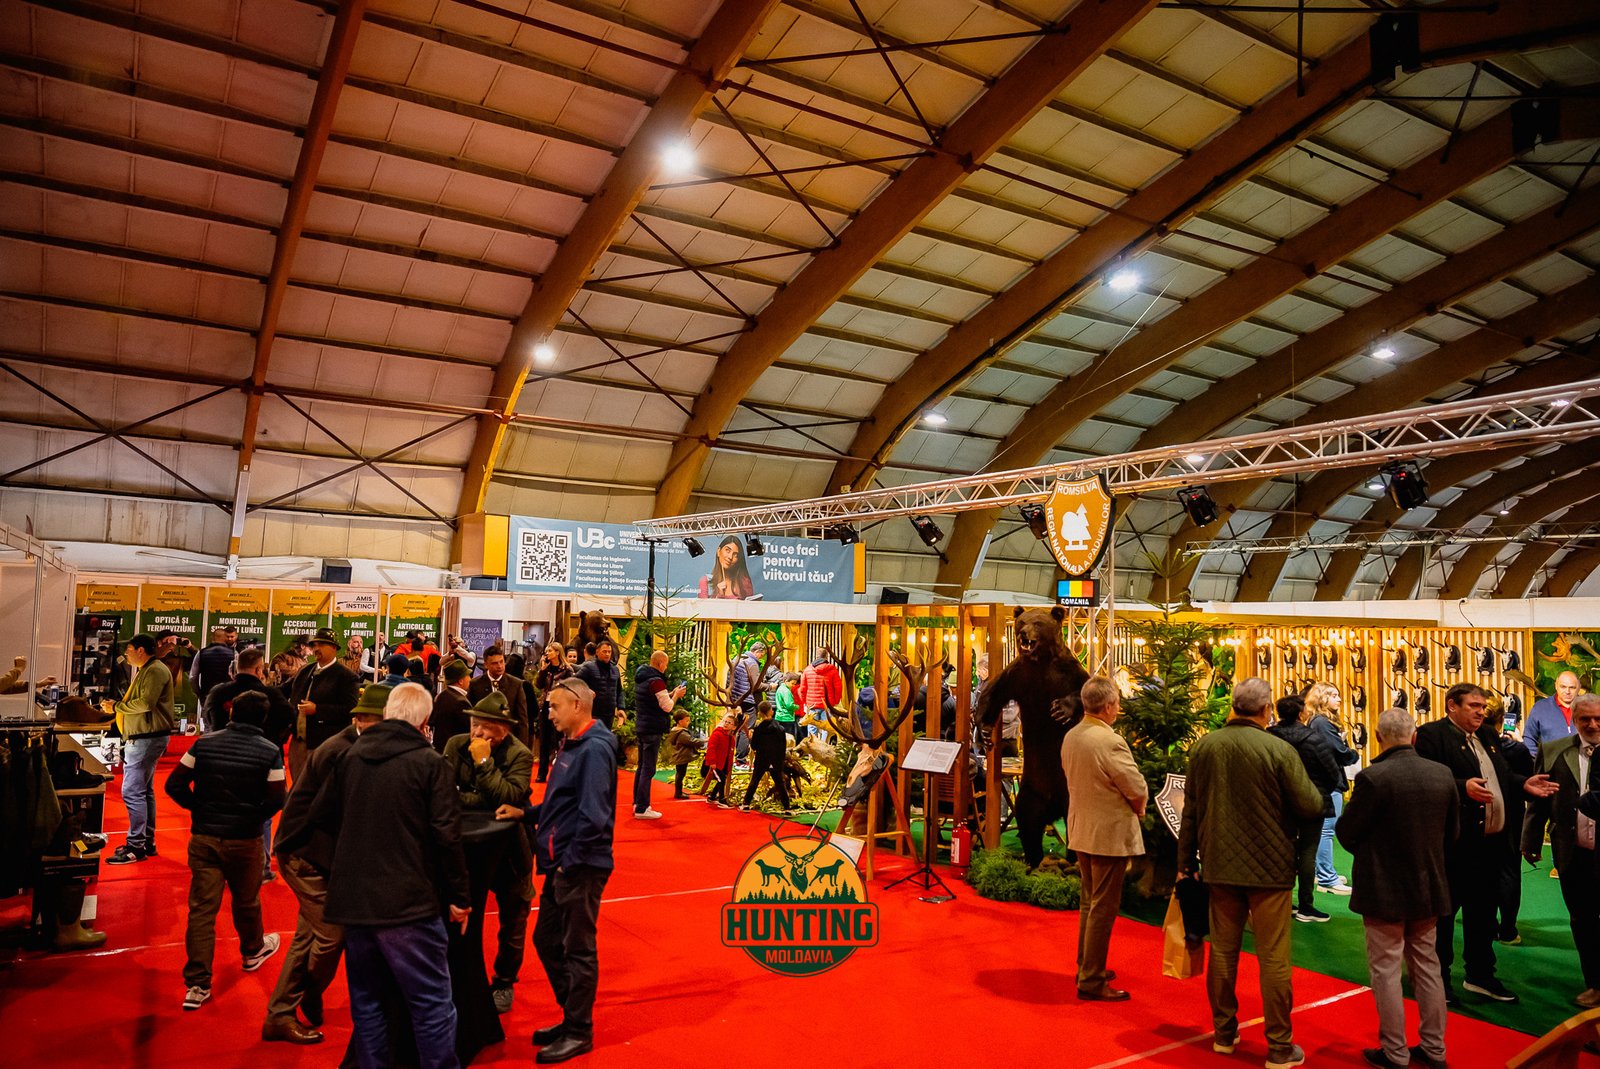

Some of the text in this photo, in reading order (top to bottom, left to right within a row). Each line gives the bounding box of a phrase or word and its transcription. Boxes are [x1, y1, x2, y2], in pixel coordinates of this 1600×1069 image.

[1057, 482, 1098, 496] ROMSILVA
[1046, 507, 1057, 538] REGIA
[1087, 502, 1110, 560] PADURILOR
[763, 542, 819, 556] Tu ce faci
[1051, 538, 1084, 574] NATIONALA
[762, 556, 804, 569] pentru
[762, 568, 835, 583] viitorul tău?
[154, 615, 180, 624] OPTICĂ
[219, 617, 248, 626] MONTURI
[283, 620, 317, 628] ACCESORII
[147, 624, 196, 633] TERMOVIZIUNE
[241, 626, 264, 634] LUNETE
[1161, 800, 1181, 832] REGIA
